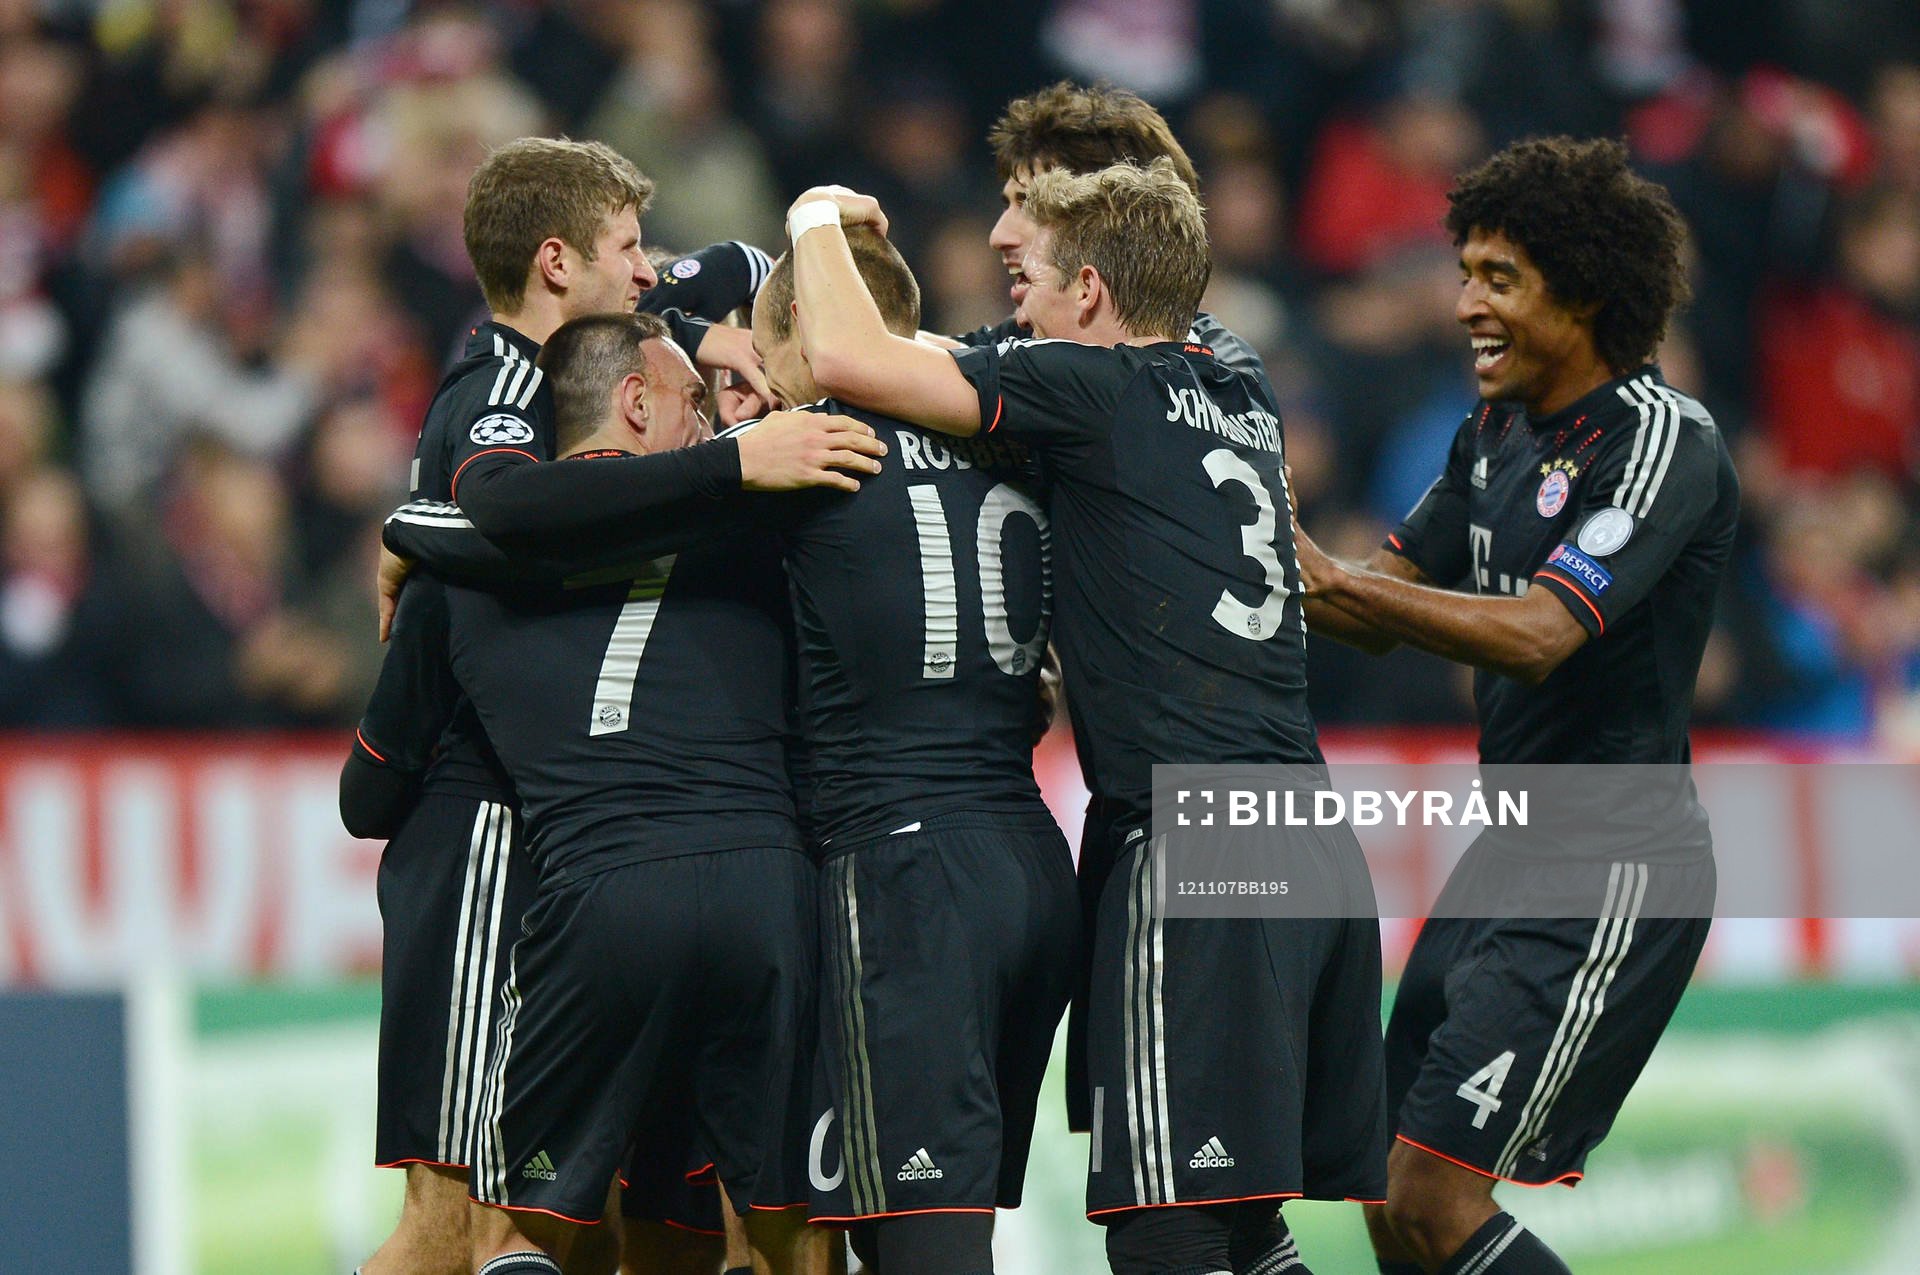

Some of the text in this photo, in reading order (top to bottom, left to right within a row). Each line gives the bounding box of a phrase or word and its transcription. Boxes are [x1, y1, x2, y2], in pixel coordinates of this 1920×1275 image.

[907, 482, 1052, 679] 10
[1559, 551, 1609, 592] RESPECT
[563, 552, 679, 737] 7
[1456, 1050, 1516, 1130] 4
[522, 1167, 557, 1181] adidas
[897, 1167, 943, 1181] adidas
[1189, 1156, 1235, 1169] adidas
